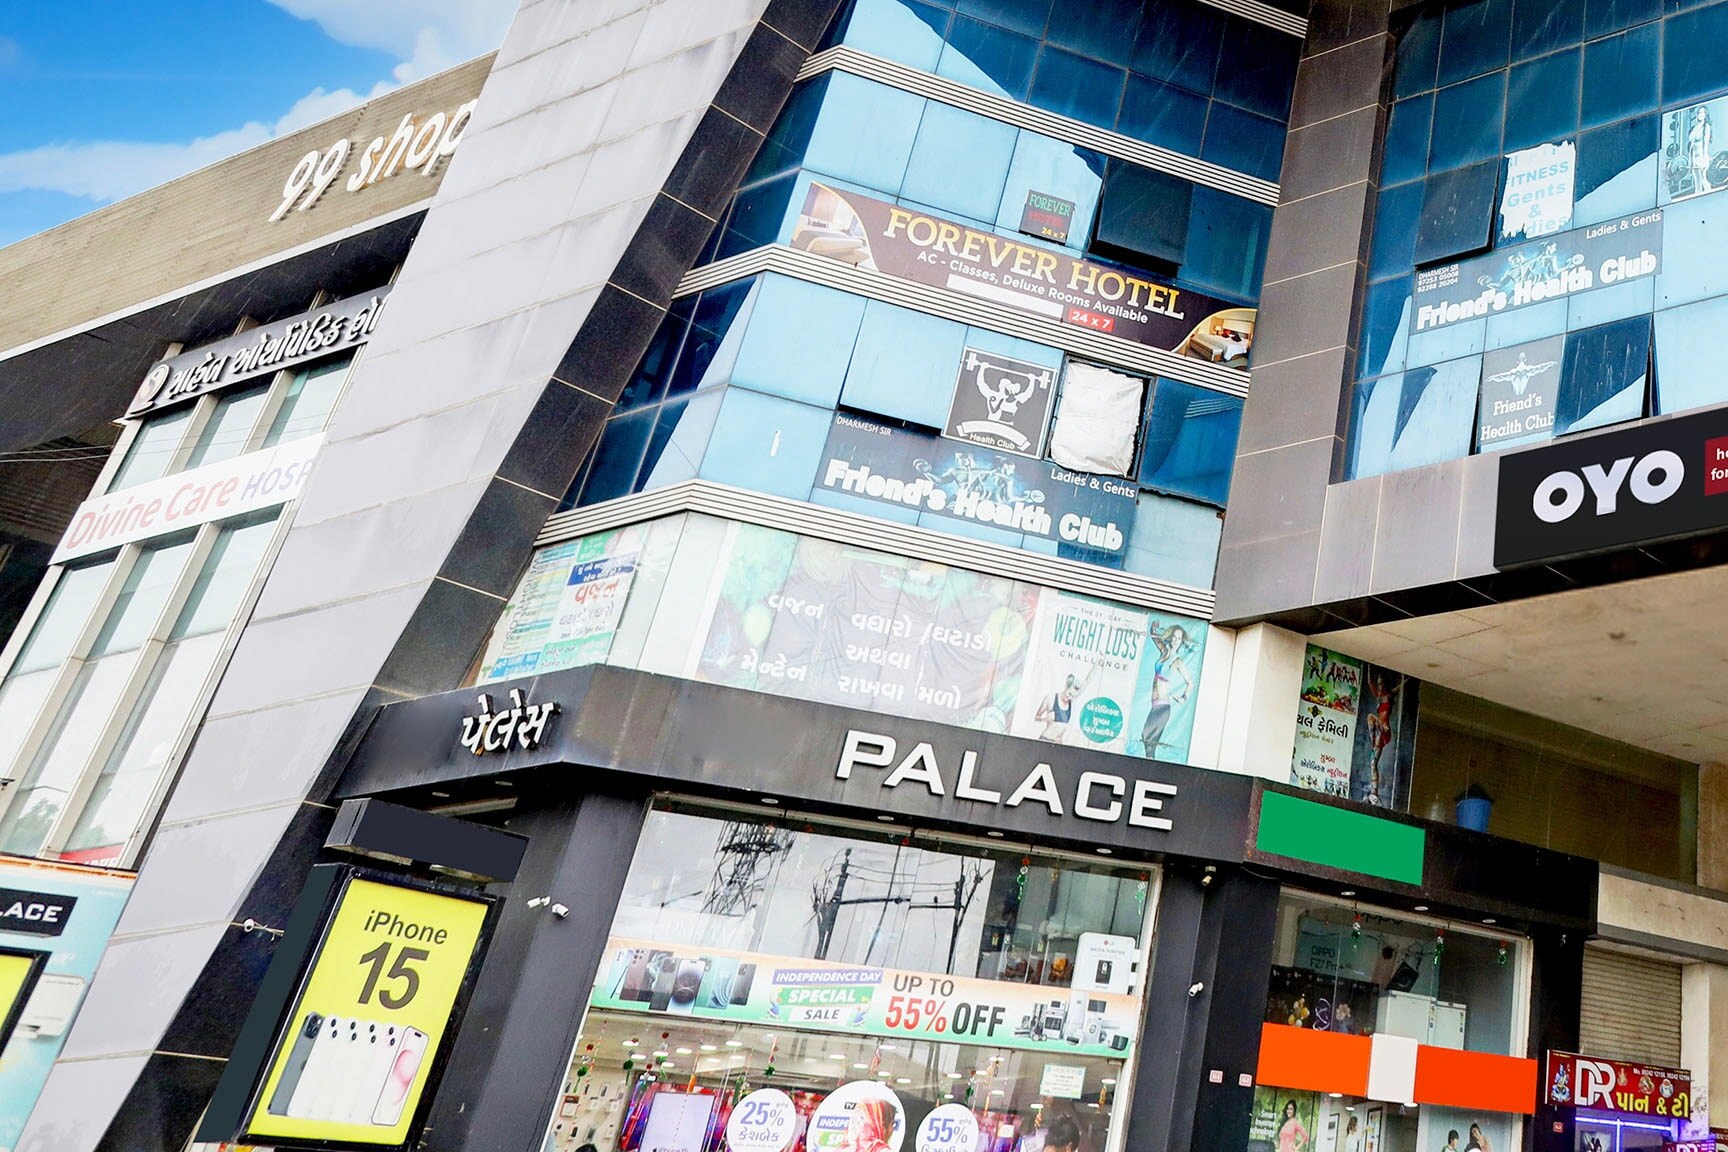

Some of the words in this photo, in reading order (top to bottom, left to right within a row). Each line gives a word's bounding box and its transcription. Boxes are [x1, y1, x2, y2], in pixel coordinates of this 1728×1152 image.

[268, 138, 352, 223] 99
[346, 99, 479, 192] shop
[1028, 194, 1071, 217] FOREVER
[1507, 184, 1566, 208] Gents
[1528, 203, 1542, 219] &
[1041, 227, 1051, 236] 24
[1059, 231, 1065, 239] 7
[1527, 215, 1568, 237] dies
[1586, 223, 1617, 239] Ladies
[1620, 219, 1629, 230] &
[1631, 211, 1662, 228] Gents
[883, 208, 1058, 284] FOREVER
[1066, 261, 1184, 321] HOTEL
[1418, 265, 1450, 280] DHARMESH
[917, 251, 938, 265] AC
[950, 259, 998, 285] Classes,
[1002, 273, 1045, 296] Deluxe
[1048, 286, 1090, 308] Rooms
[1093, 299, 1149, 324] Available
[1417, 288, 1507, 330] Friend's
[1513, 266, 1593, 306] Health
[1600, 250, 1657, 284] Club
[1072, 311, 1088, 323] 24
[1102, 318, 1111, 329] 7
[1493, 392, 1542, 417] Friend's
[836, 416, 878, 434] DHARMESH
[879, 427, 892, 437] SIR
[1480, 420, 1521, 441] Health
[1525, 410, 1555, 430] Club
[969, 432, 996, 447] Health
[997, 438, 1016, 450] Club
[1051, 468, 1088, 487] Ladies
[1089, 478, 1100, 490] &
[1102, 481, 1135, 499] Gents
[1532, 449, 1685, 523] OYO
[66, 496, 156, 549] Divine
[165, 476, 239, 521] Care
[824, 459, 947, 511] Friend's
[953, 489, 1052, 535] Health
[1058, 513, 1124, 551] Club
[1081, 608, 1093, 616] THE
[1053, 613, 1105, 653] WEIGHT
[1105, 628, 1140, 660] LOSS
[1059, 650, 1128, 672] CHALLENGE
[461, 687, 555, 755] પેલેસ
[1317, 717, 1349, 738] ફેમિલી
[836, 729, 1178, 831] PALACE
[0, 900, 62, 924] ACE
[364, 910, 447, 944] iPhone
[1311, 945, 1335, 958] OPPO
[358, 942, 430, 1009] 15
[1309, 958, 1323, 970] F27
[775, 971, 857, 984] INDEPENDENCE
[858, 971, 882, 984] DAY
[893, 974, 922, 993] UP
[931, 979, 955, 997] TO
[788, 988, 857, 1003] SPECIAL
[804, 1008, 840, 1021] SALE
[885, 996, 947, 1033] 55%
[952, 1002, 1006, 1037] OFF
[1575, 1058, 1616, 1109] DR
[1616, 1091, 1649, 1113] પાન
[1656, 1097, 1668, 1116] &
[1671, 1092, 1689, 1118] ટી
[740, 1101, 784, 1127] 25%
[845, 1102, 856, 1110] TV
[739, 1126, 780, 1142] કેશબેક
[926, 1117, 968, 1144] 55%
